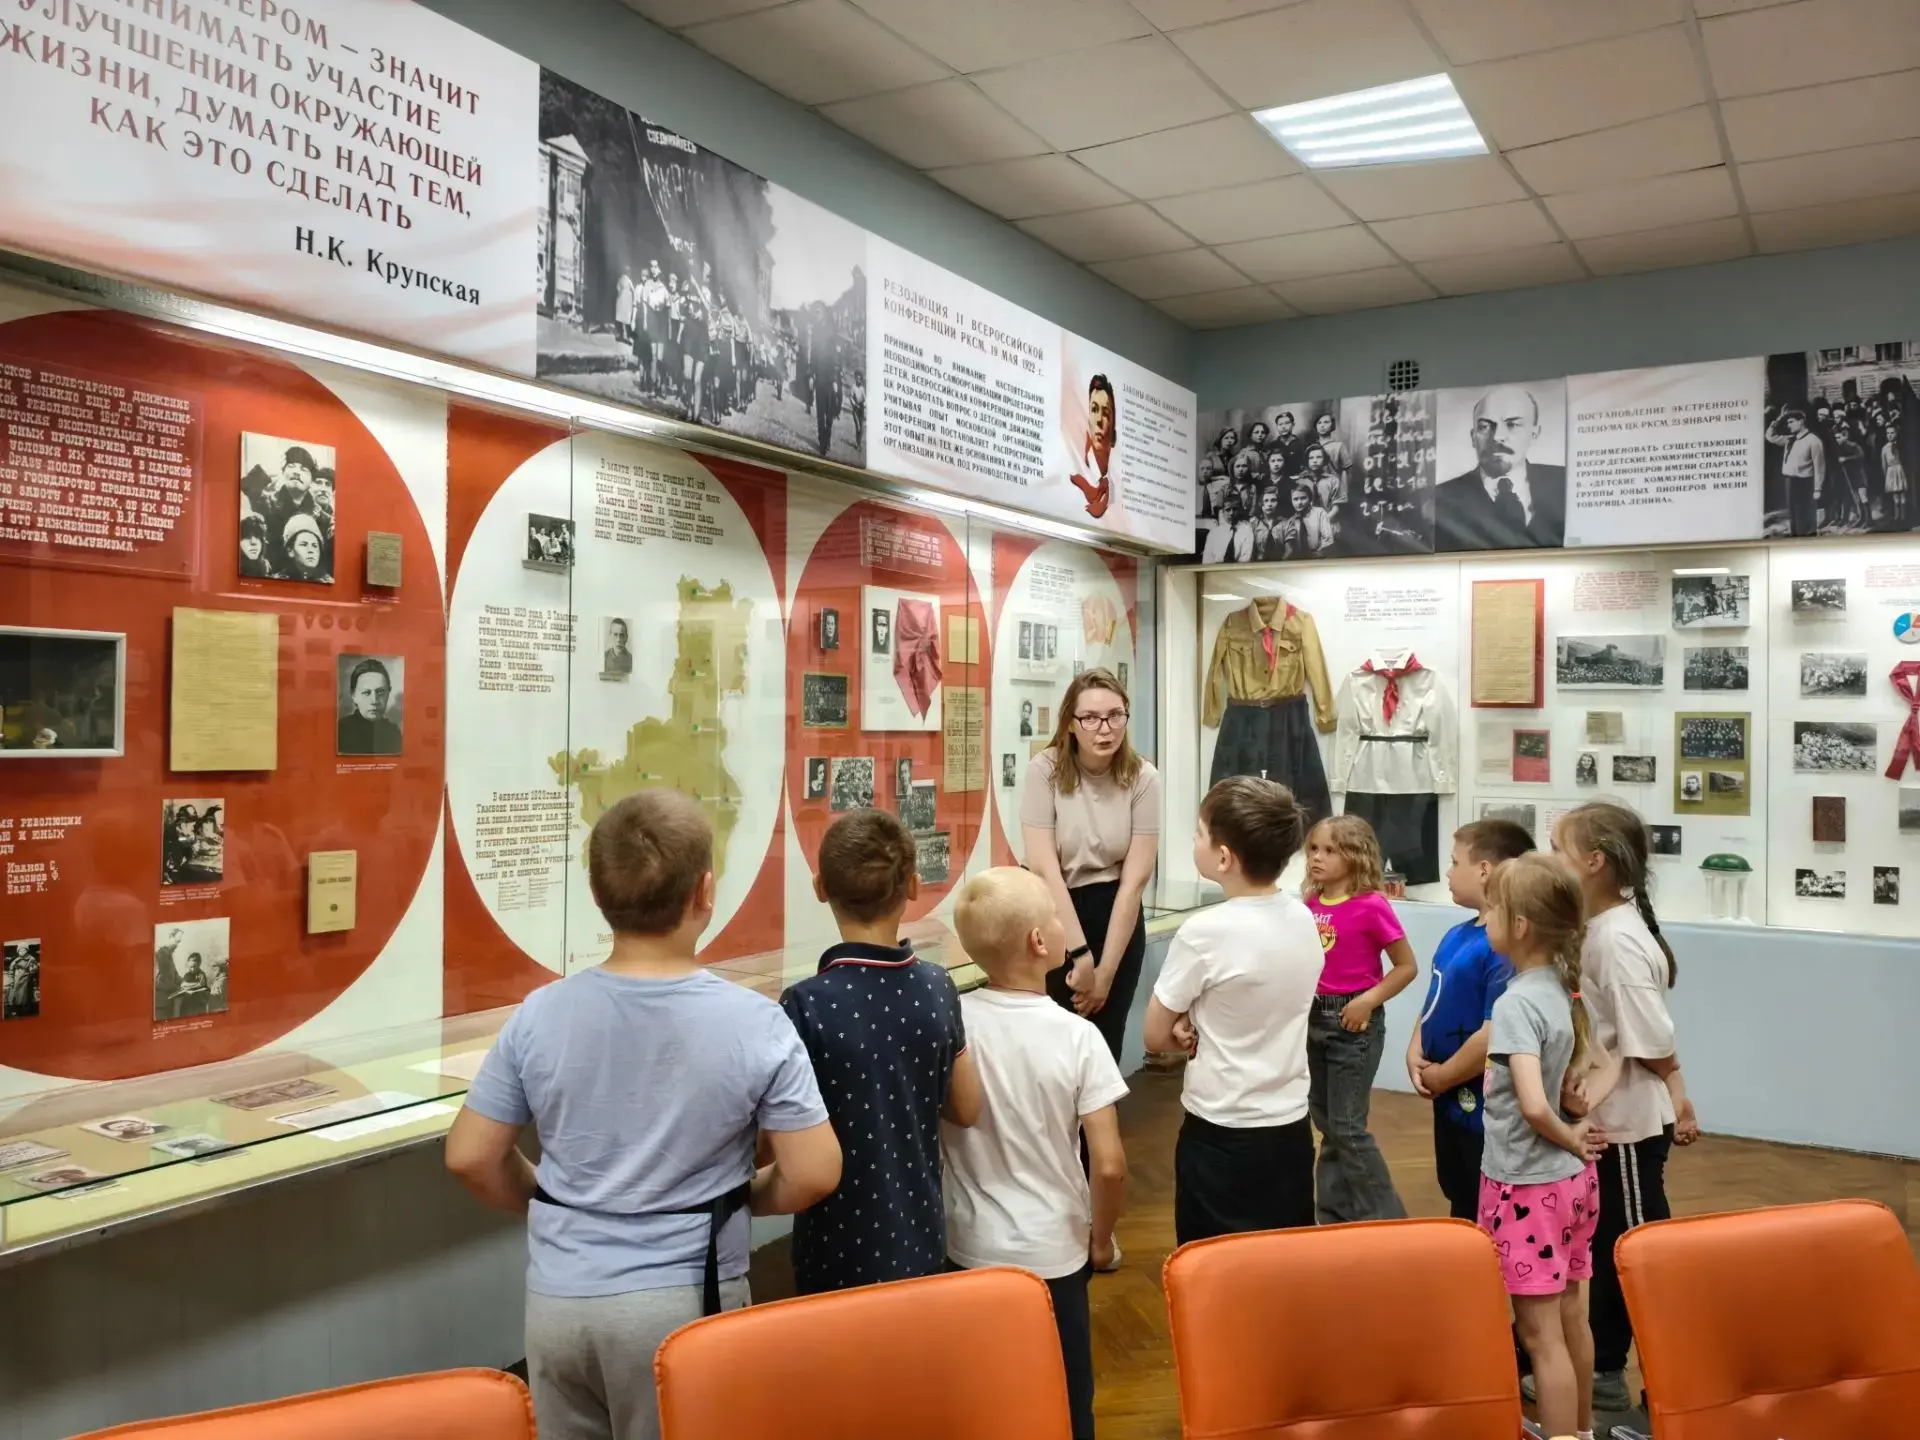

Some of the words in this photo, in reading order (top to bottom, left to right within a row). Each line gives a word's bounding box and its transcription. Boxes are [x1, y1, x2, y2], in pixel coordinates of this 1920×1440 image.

[114, 0, 293, 72] НИМАТЬ
[306, 56, 442, 135] УЧАСТИЕ
[213, 0, 328, 50] ЕРОМ
[369, 47, 480, 116] ЗНАЧИТ
[0, 18, 160, 108] ЖИЗНИ,
[175, 86, 321, 161] ДУМАТЬ
[336, 145, 397, 192] НАД
[409, 172, 472, 219] ТЕМ,
[270, 82, 483, 187] ОКРУЖАЮЩЕЙ
[90, 97, 169, 151] КАК
[183, 130, 251, 175] ЭТО
[266, 160, 413, 230] СДЕЛАТЬ
[295, 225, 353, 268] Н.К.
[367, 247, 480, 306] Крупская
[884, 278, 948, 318] РЕЗОЛЮЦИЯ
[971, 319, 1044, 360] ВСЕРОССИЙСКОЙ
[884, 297, 956, 339] КОНФЕРЕНЦИИ
[991, 345, 998, 357] 19
[1002, 349, 1018, 366] МАЯ
[884, 333, 923, 358] ПРИНИМАЯ
[933, 354, 943, 365] ВО
[952, 361, 986, 383] ВНИМАНИЕ
[884, 348, 942, 380] НЕОБХОДИМОСТЬ
[942, 371, 1001, 401] САМООРГАНИЗАЦИИ
[23, 382, 79, 403] ВОЗНИКЛО
[86, 394, 111, 410] ЕЩЕ
[119, 401, 133, 414] ДО
[40, 371, 125, 398] ПРОЛЕТАРСКОЕ
[132, 391, 189, 410] ДВИЖЕНИЕ
[883, 377, 893, 389] ЦК
[896, 383, 944, 407] РАЗРАБОТАТЬ
[946, 400, 971, 417] ВОПРОС
[973, 410, 978, 419] О
[979, 412, 1007, 430] ДЕТСКОМ
[911, 374, 968, 402] ВСЕРОССИЙСКАЯ
[969, 395, 1013, 419] КОНФЕРЕНЦИЯ
[1015, 412, 1044, 430] ПОРУЧАЕТ
[27, 398, 93, 420] РЕВОЛЮЦИИ
[883, 392, 922, 413] УЧИТЫВАЯ
[929, 408, 948, 423] ОПЫТ
[956, 417, 997, 438] МОСКОВСКОЙ
[1577, 407, 1665, 421] ПОСТАНОВЛЕНИЕ
[1672, 399, 1748, 412] ЭКСТРЕННОГО
[1577, 424, 1622, 434] ПЛЕНУМА
[1625, 423, 1638, 431] ЦК
[1682, 415, 1721, 426] ЯНВАРЯ
[8, 424, 44, 440] ЮНЫХ
[58, 418, 143, 442] ЭКСПЛУАТАЦИЯ
[147, 434, 155, 445] И
[883, 406, 936, 432] КОНФЕРЕНЦИЯ
[940, 425, 989, 450] ПОСТАНОВЛЯЕТ
[883, 421, 902, 435] ЭТОТ
[904, 428, 925, 443] ОПЫТ
[928, 435, 937, 446] НА
[939, 439, 952, 451] ТЕХ
[954, 443, 964, 455] ЖЕ
[9, 439, 61, 457] УСЛОВИЯ
[68, 449, 85, 461] ИХ
[94, 453, 132, 468] ЖИЗНИ
[139, 460, 145, 470] В
[149, 462, 192, 477] ЦАРСКОЙ
[883, 436, 934, 460] ОРГАНИЗАЦИИ
[957, 458, 970, 472] ПОД
[972, 462, 1018, 484] РУКОВОДСТВОМ
[1577, 445, 1659, 457] ПЕРЕИМЕНОВАТЬ
[1663, 438, 1747, 450] СУЩЕСТВУЮЩИЕ
[1584, 459, 1605, 467] СССР
[1607, 456, 1648, 466] ДЕТСКИЕ
[1650, 449, 1748, 462] КОММУНИСТИЧЕСКИЕ
[24, 471, 96, 491] ГОСУДАРСТВО
[101, 482, 161, 500] ПРОЯВЛЯЛИ
[47, 460, 82, 475] ПОСЛЕ
[140, 474, 179, 490] ПАРТИЯ
[184, 480, 191, 491] И
[1576, 469, 1613, 478] ГРУППЫ
[1615, 466, 1662, 475] ПИОНЕРОВ
[1665, 463, 1697, 472] ИМЕНИ
[1699, 460, 1748, 470] СПАРТАКА
[1644, 470, 1748, 484] КОММУНИСТИЧЕСКИЕ
[19, 485, 61, 501] ЗАБОТУ
[68, 491, 75, 503] О
[125, 499, 137, 511] ОБ
[141, 501, 157, 513] ИХ
[1576, 489, 1614, 498] ГРУППЫ
[1620, 487, 1649, 496] ЮНЫХ
[1656, 483, 1707, 493] ПИОНЕРОВ
[1713, 481, 1748, 490] ИМЕНИ
[1576, 499, 1626, 509] ТОВАРИЩА
[10, 513, 31, 526] ЭТО
[36, 516, 109, 536] ВАЖНЕЙШЕЙ
[114, 526, 164, 542] ЗАДАЧЕЙ
[20, 815, 82, 828] РЕВОЛЮЦИИ
